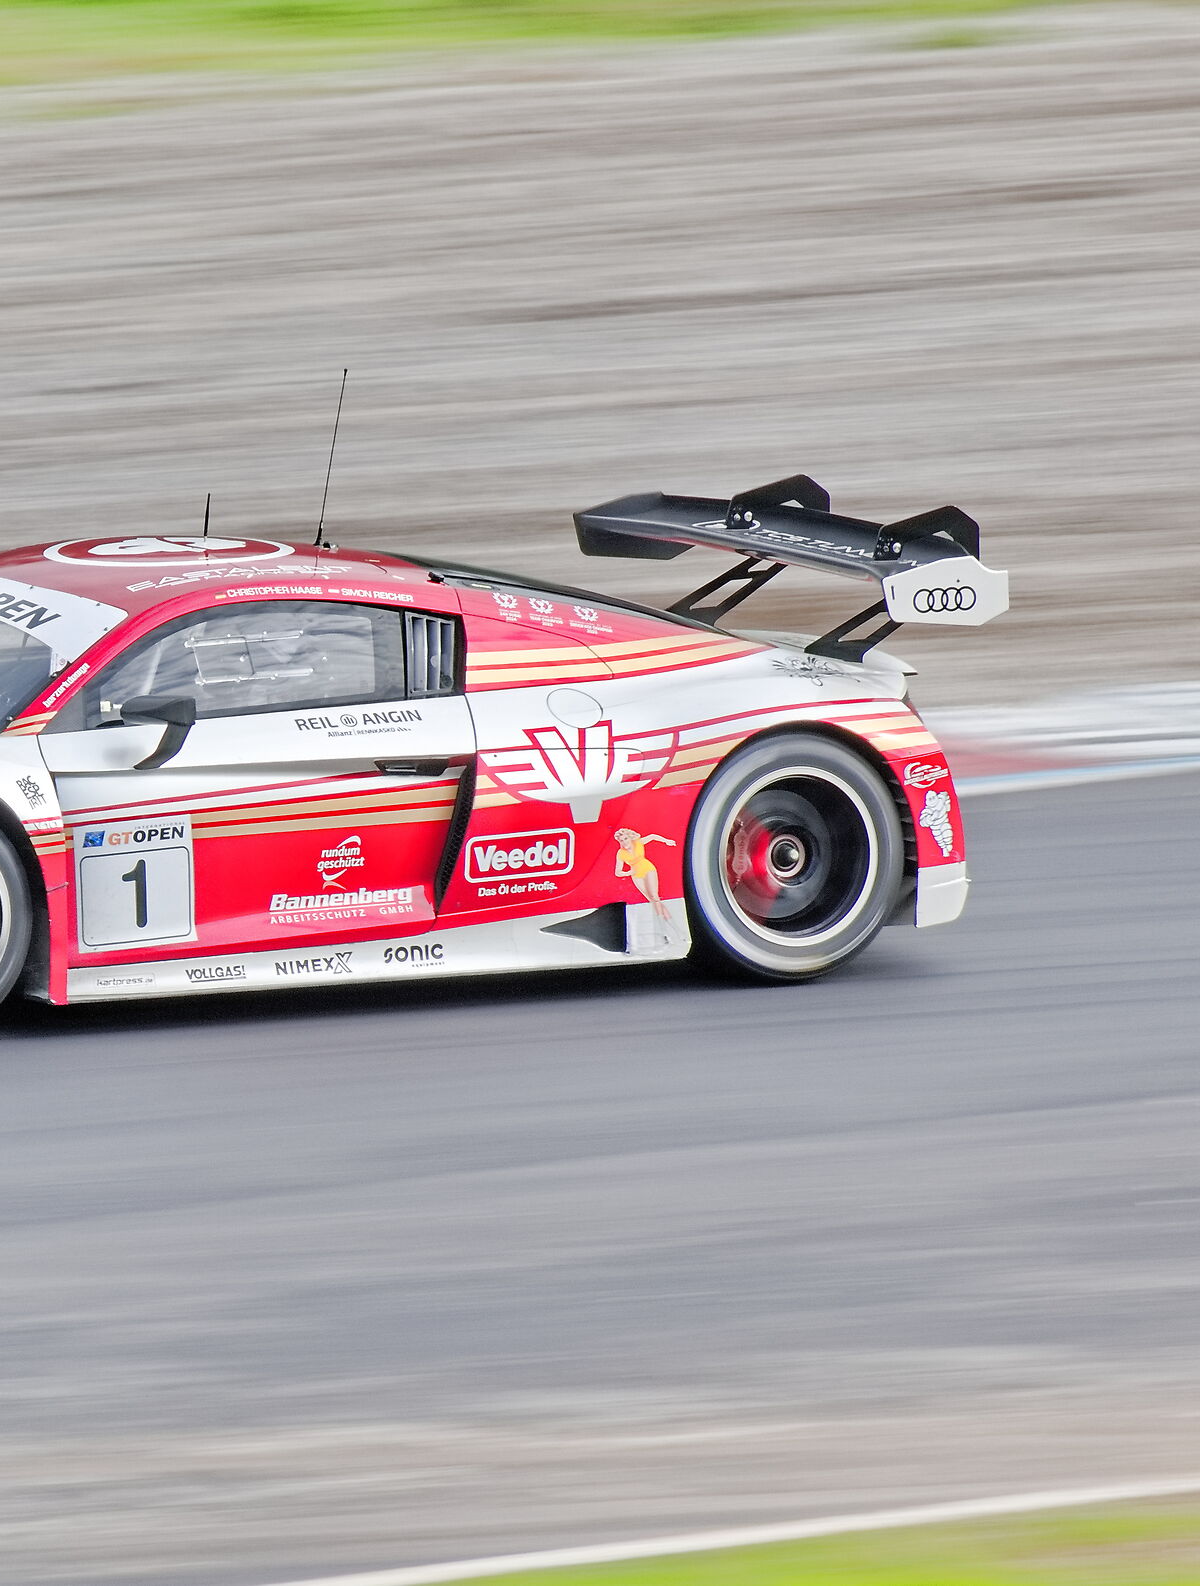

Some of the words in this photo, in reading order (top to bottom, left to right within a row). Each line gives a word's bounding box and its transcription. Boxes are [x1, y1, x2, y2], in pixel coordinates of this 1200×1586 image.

[227, 586, 290, 598] CHRISTOPHER
[290, 586, 323, 595] HAASE
[341, 588, 373, 598] SIMON
[373, 590, 414, 602] REICHER
[294, 716, 339, 731] REIL
[362, 709, 423, 725] ANGIN
[328, 730, 353, 738] Allianz
[321, 846, 361, 858] rundum
[474, 838, 567, 872] Veedol
[317, 856, 366, 872] geschützt
[121, 859, 148, 928] 1
[269, 886, 413, 911] Bannenberg
[478, 887, 497, 897] Das
[498, 883, 509, 895] Öl
[510, 884, 527, 894] der
[270, 909, 367, 925] ARBEITSSCHUTZ
[379, 904, 414, 915] GMBH
[383, 943, 444, 964] SONIC
[185, 965, 246, 980] VOLLGAS!
